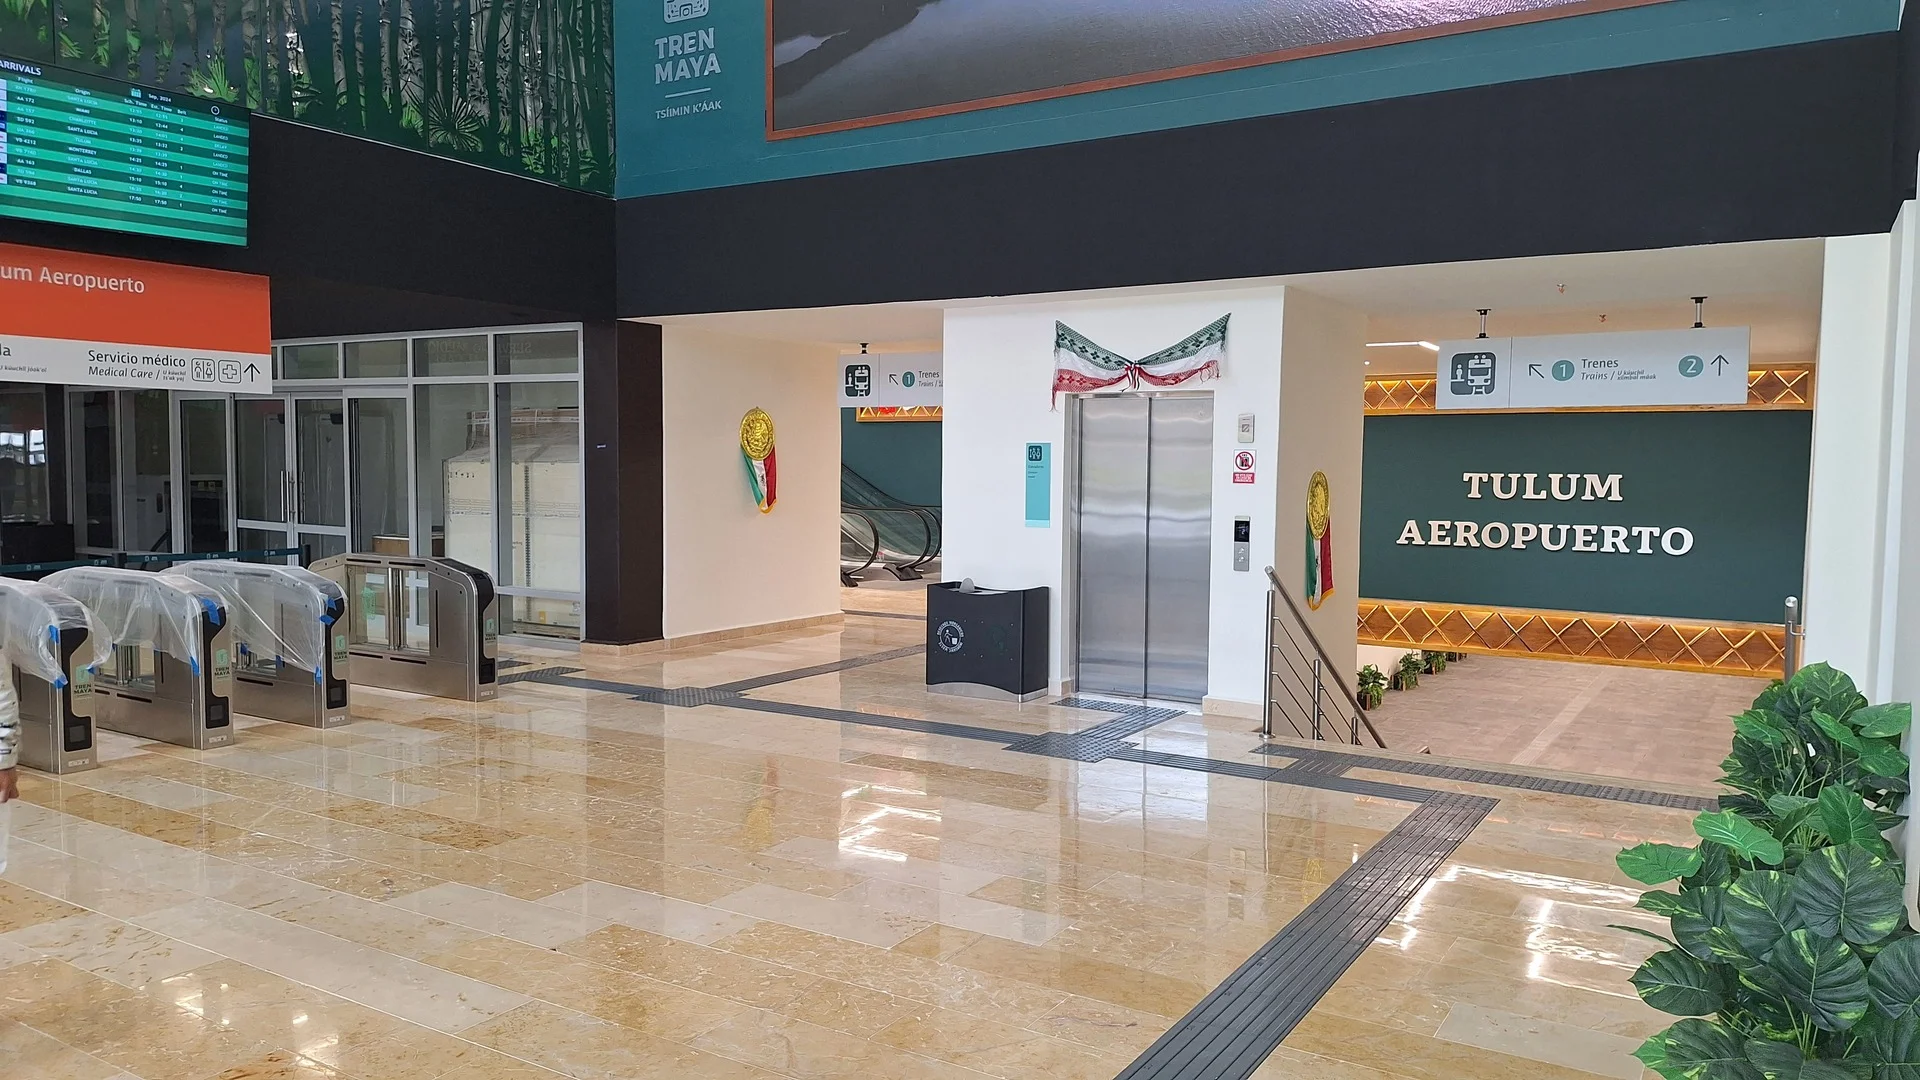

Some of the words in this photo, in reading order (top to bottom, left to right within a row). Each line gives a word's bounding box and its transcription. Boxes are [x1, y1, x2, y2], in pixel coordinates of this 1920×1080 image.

[655, 27, 714, 59] TREN
[0, 60, 41, 76] ARRIVALS
[655, 52, 721, 84] MAYA
[656, 105, 690, 119] TSÍIMIN
[69, 147, 96, 155] MONTERREY
[40, 266, 145, 293] Aeropuerto
[88, 350, 138, 364] Servicio
[143, 354, 186, 367] médico
[1581, 359, 1618, 368] Trenes
[88, 366, 127, 377] Medical
[131, 368, 153, 378] Care
[1581, 372, 1608, 380] Trains
[1463, 472, 1623, 501] TULUM
[1396, 520, 1694, 556] AEROPUERTO
